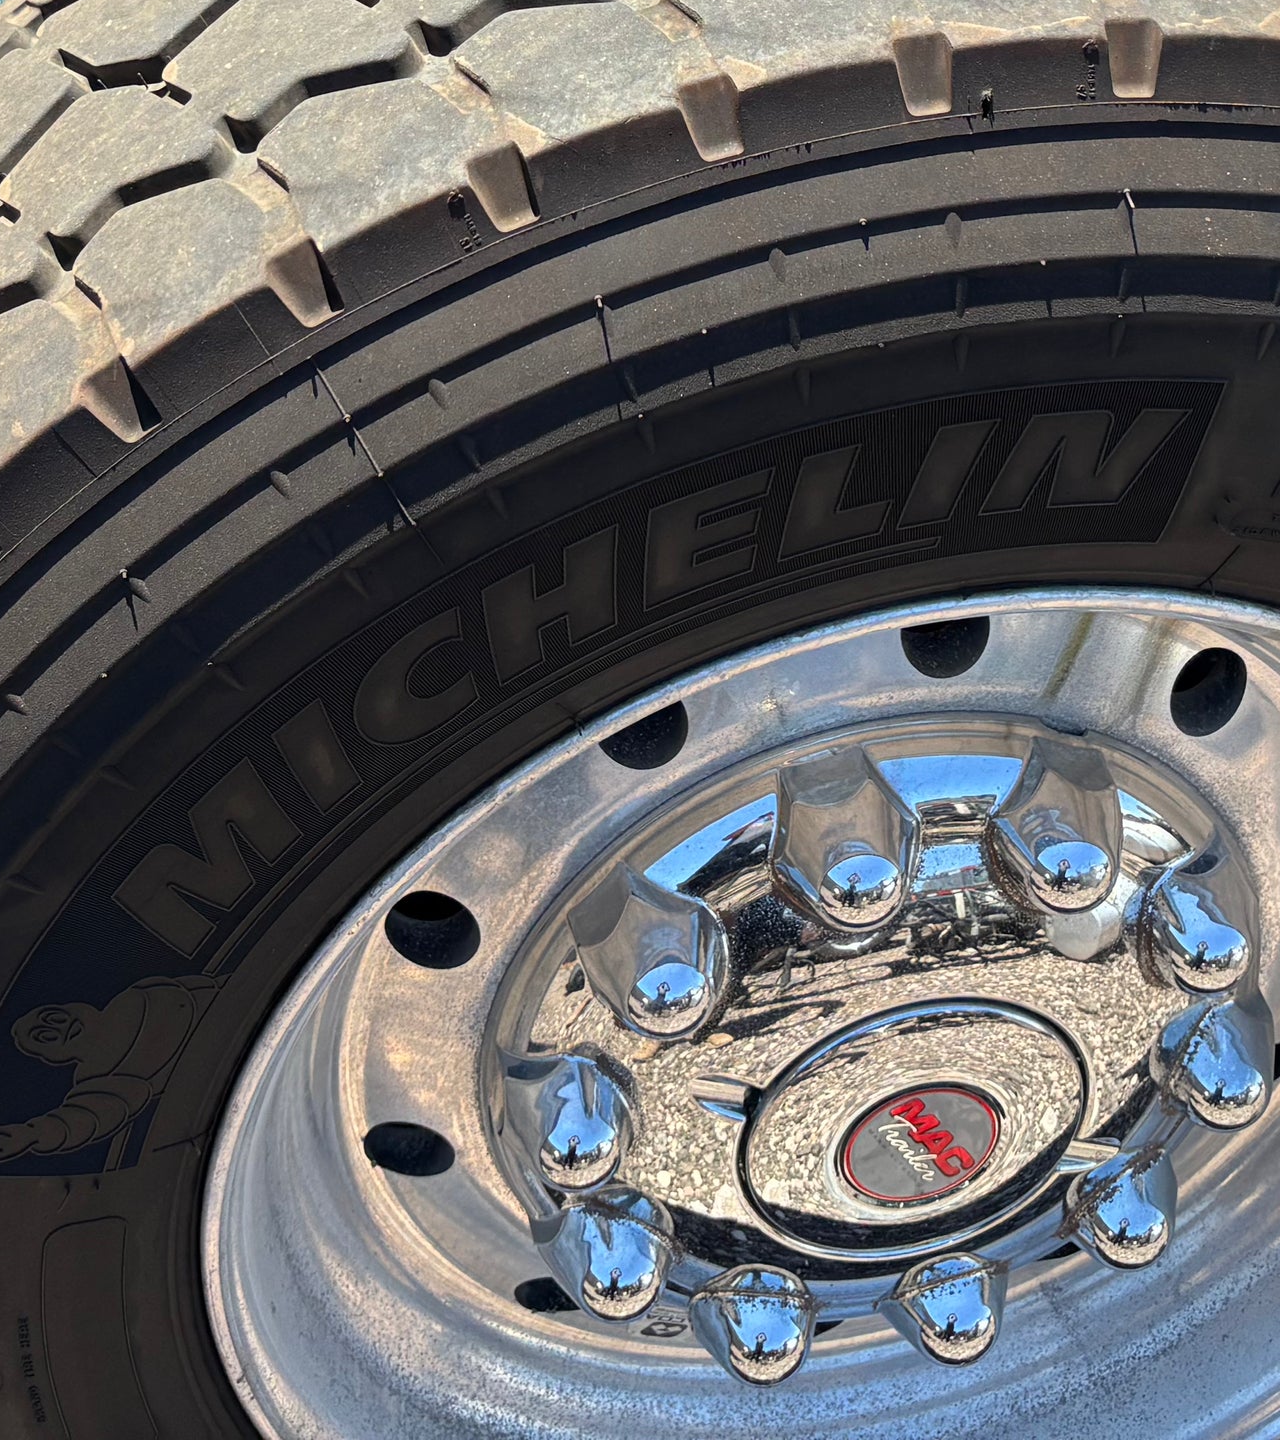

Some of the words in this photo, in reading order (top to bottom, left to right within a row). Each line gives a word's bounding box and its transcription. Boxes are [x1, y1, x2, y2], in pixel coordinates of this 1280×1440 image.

[112, 407, 1192, 958] MICHELIN
[878, 1114, 937, 1182] Trailer
[889, 1097, 976, 1178] MAC
